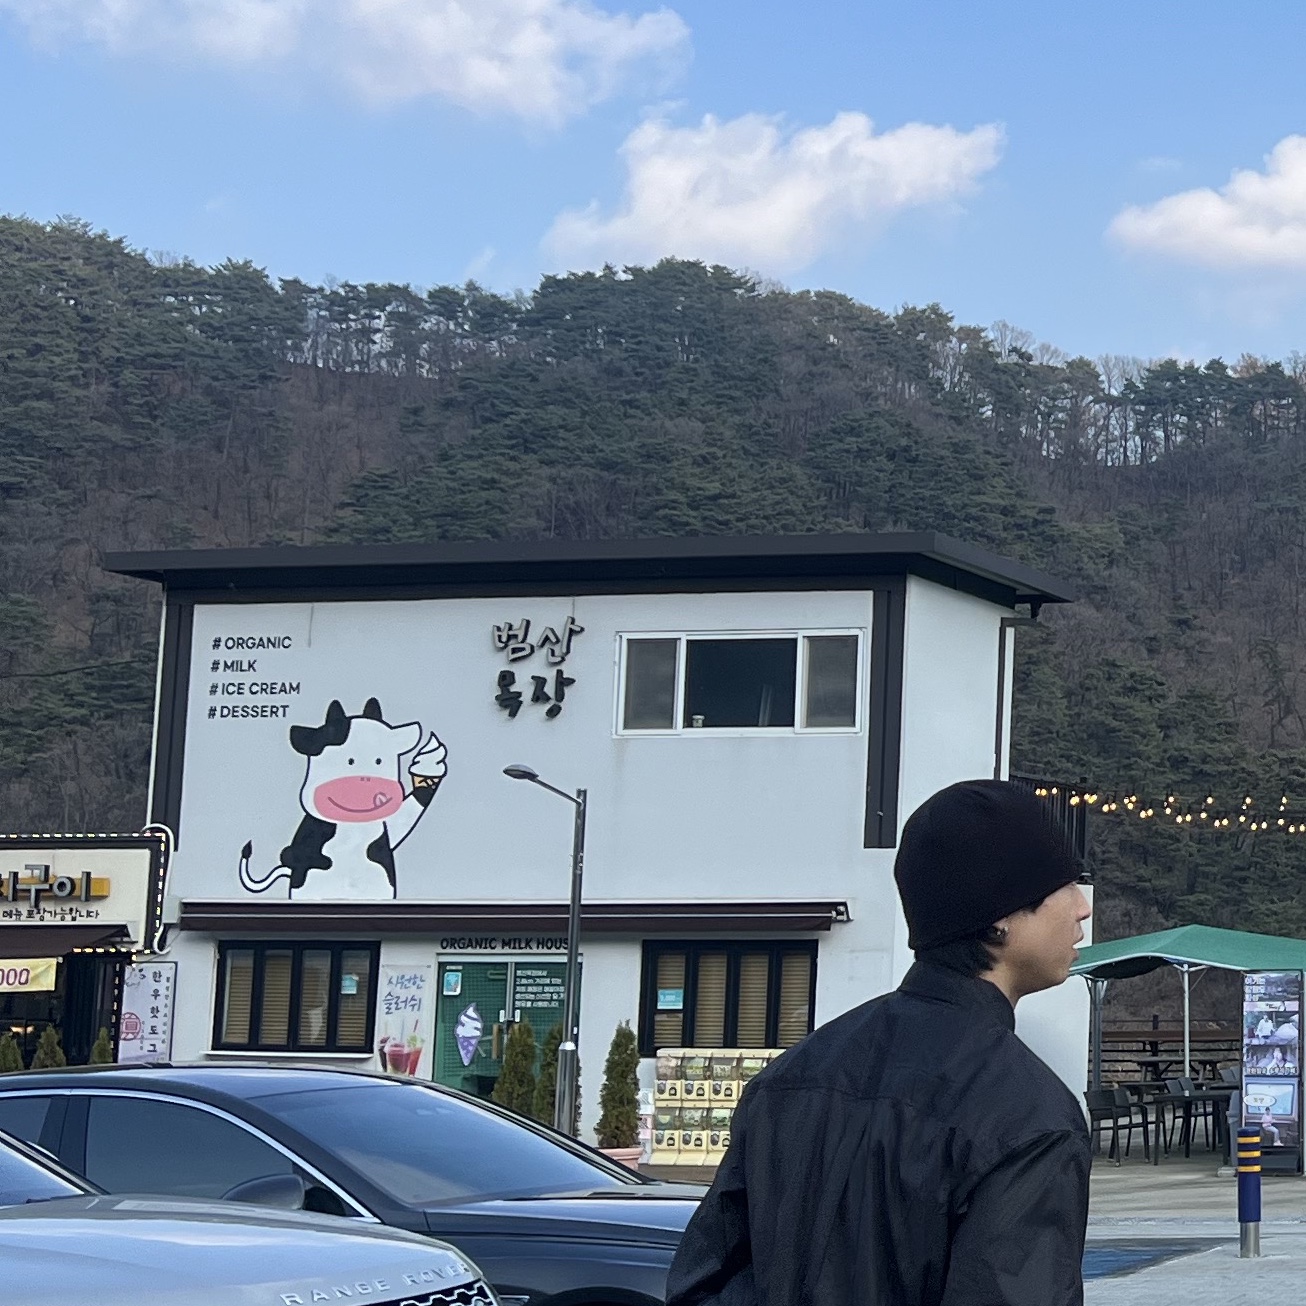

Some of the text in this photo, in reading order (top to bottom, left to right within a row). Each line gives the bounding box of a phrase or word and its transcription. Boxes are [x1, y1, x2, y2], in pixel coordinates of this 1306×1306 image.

[492, 615, 585, 664] 범산
[249, 682, 300, 695] CREAM
[440, 936, 569, 950] ORGANIC MILK HOUS
[386, 973, 426, 990] 시원한
[382, 991, 422, 1015] 슬러쉬
[280, 1262, 470, 1306] RANGE ROVER
